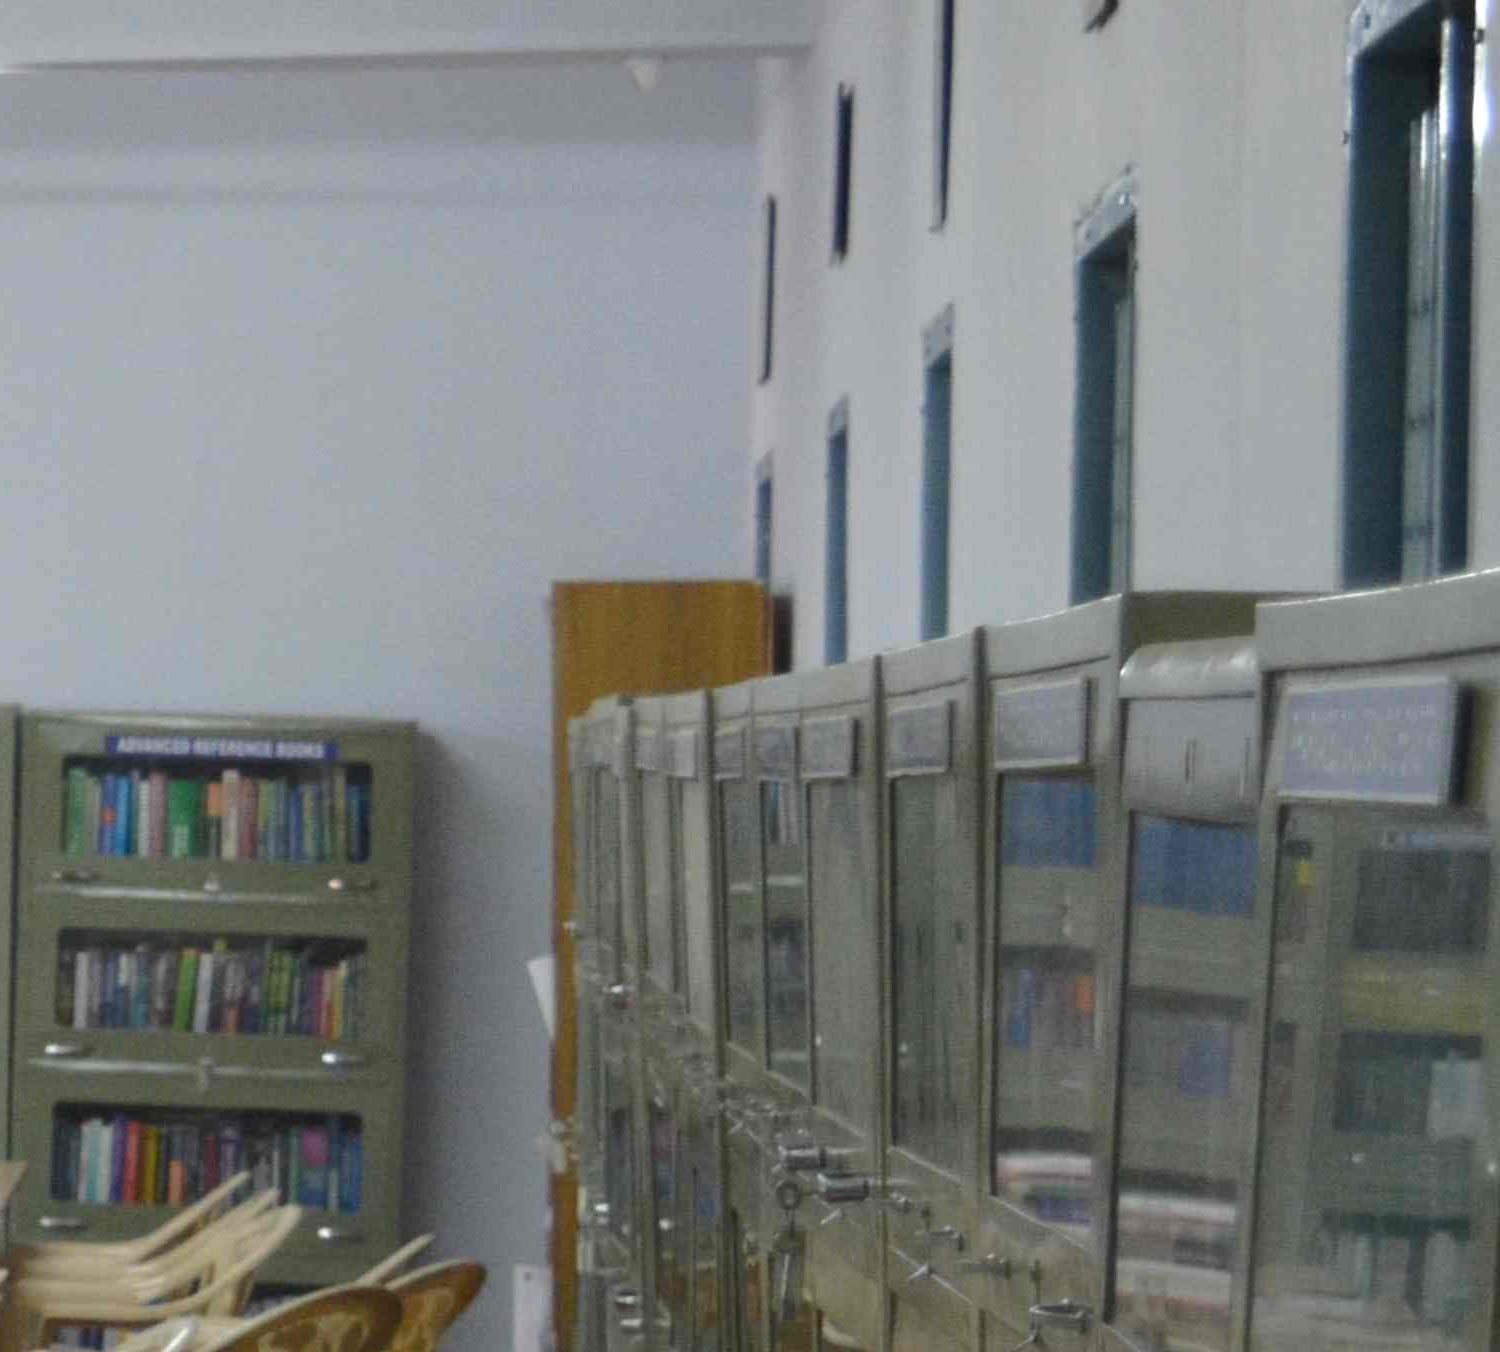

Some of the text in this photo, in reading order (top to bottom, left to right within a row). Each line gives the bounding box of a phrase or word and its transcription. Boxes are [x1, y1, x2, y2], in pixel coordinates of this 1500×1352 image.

[116, 736, 325, 759] ADVANCED REFERENCE BOOKS
